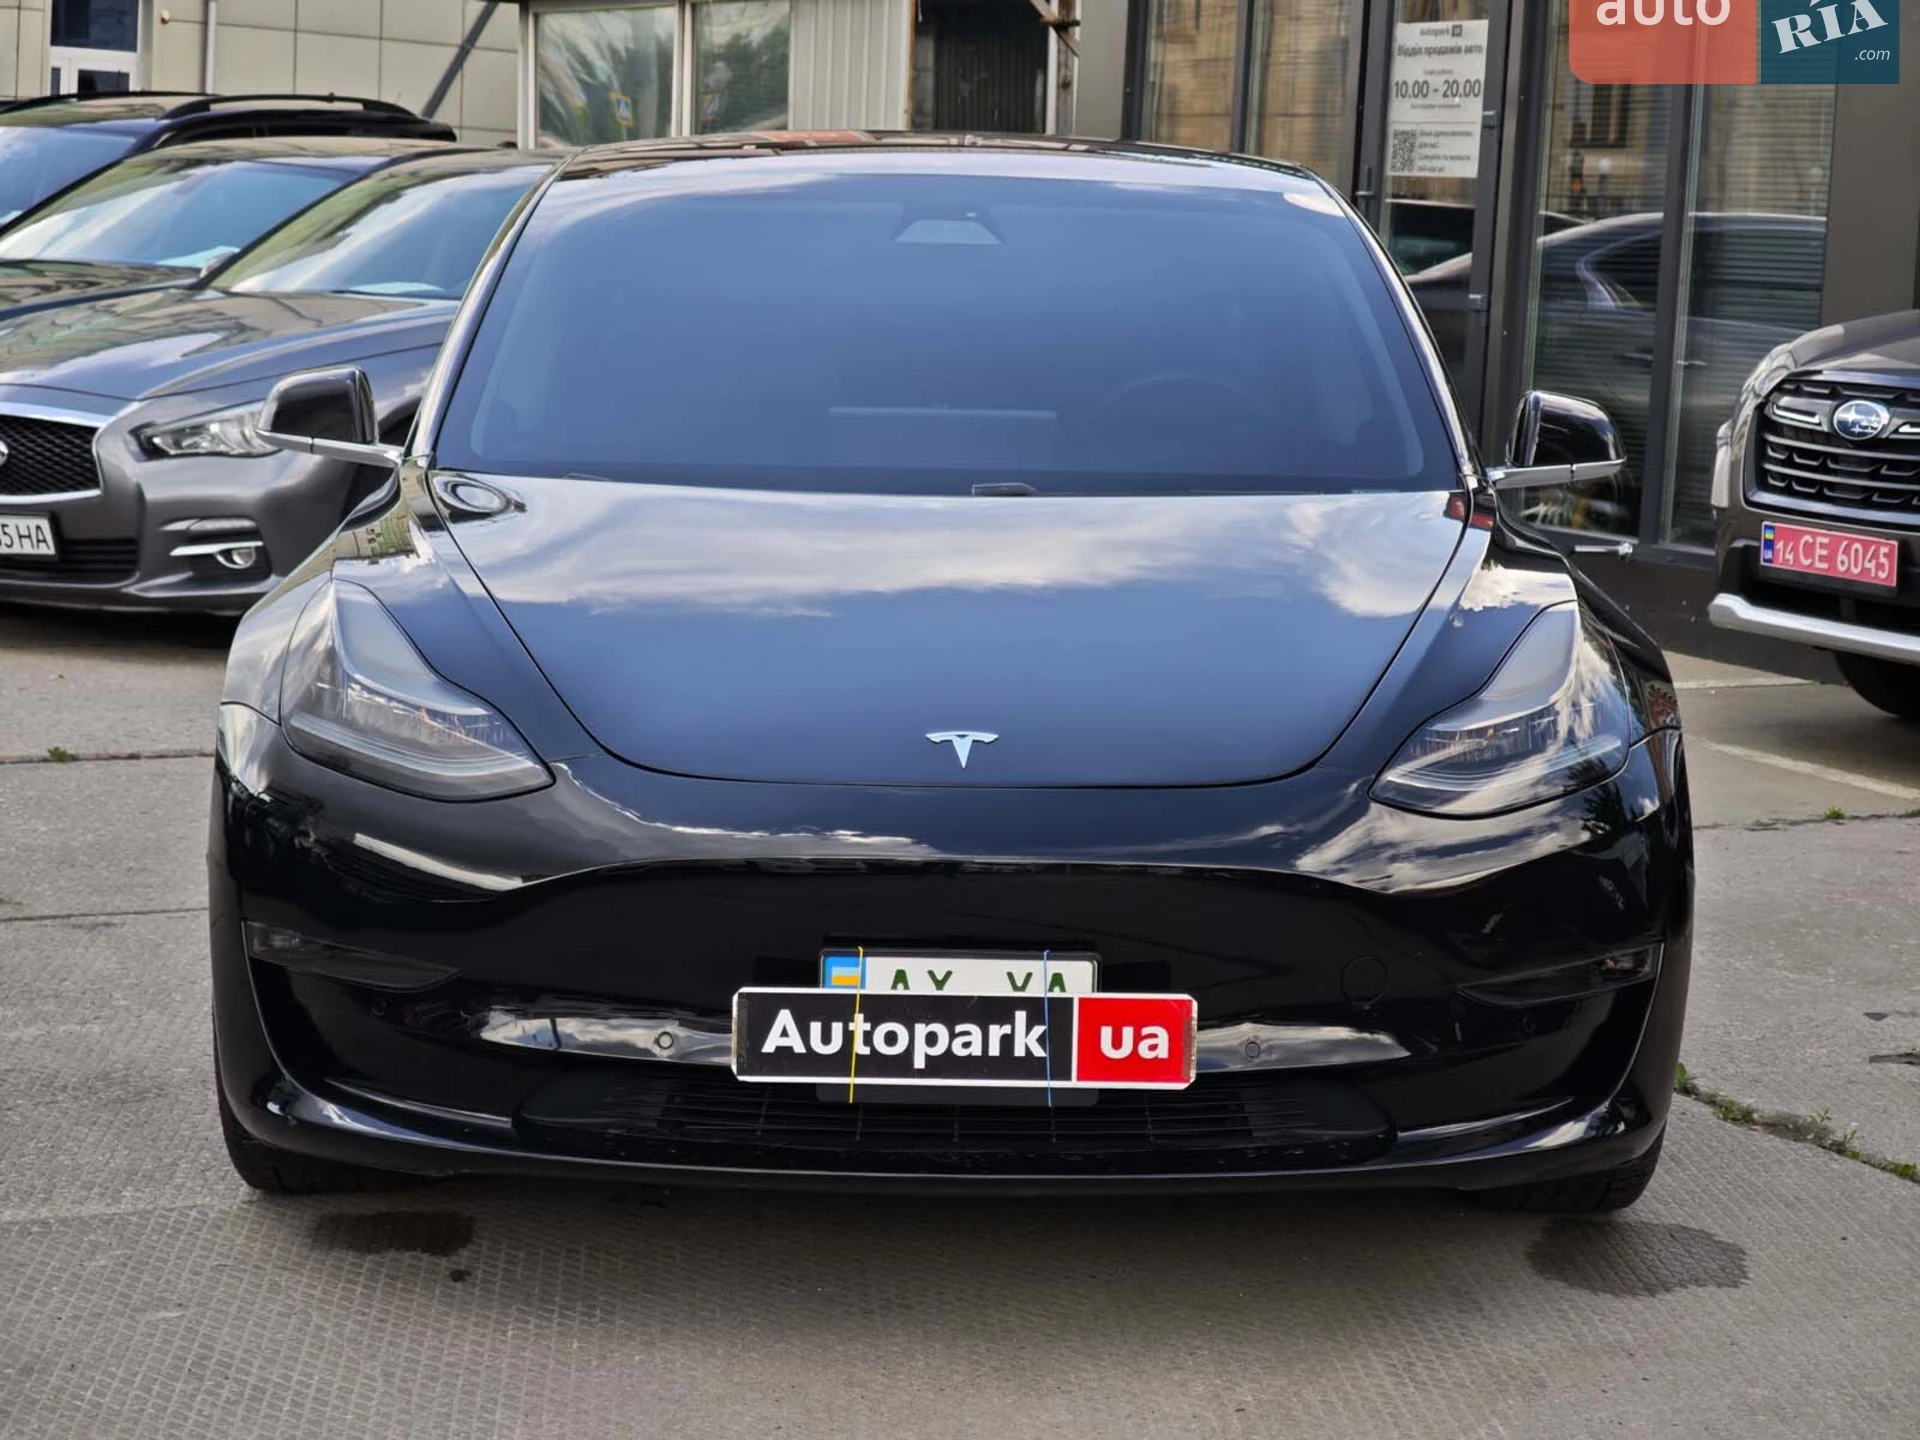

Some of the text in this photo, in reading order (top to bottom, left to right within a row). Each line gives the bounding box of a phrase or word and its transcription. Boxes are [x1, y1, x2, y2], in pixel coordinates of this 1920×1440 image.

[1394, 80, 1429, 98] 10.00
[1442, 79, 1481, 98] 20.00
[0, 523, 50, 550] 5HA
[1776, 535, 1890, 579] 14 CE 6045
[760, 1008, 1170, 1069] Autopark ua
